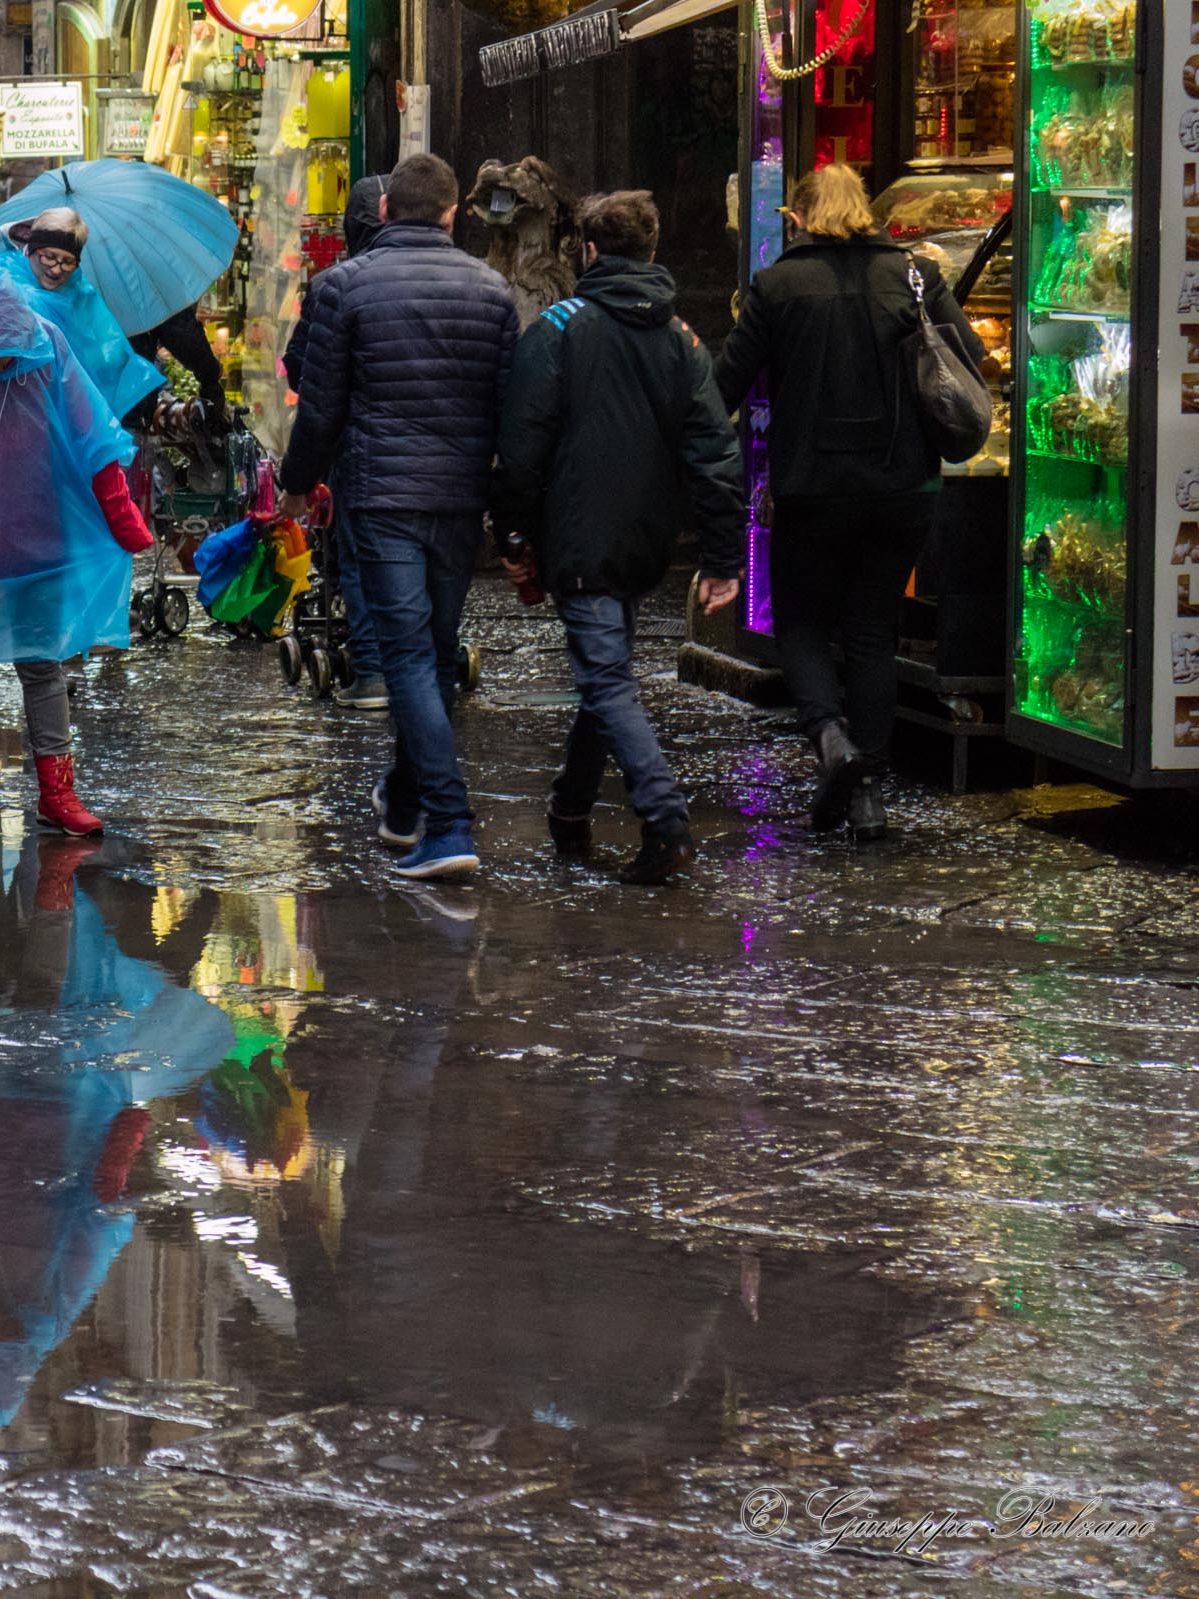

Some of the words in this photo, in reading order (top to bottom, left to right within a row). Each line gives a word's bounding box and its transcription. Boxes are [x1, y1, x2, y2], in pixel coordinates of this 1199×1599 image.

[7, 129, 75, 139] MOZZARELLA
[15, 141, 26, 149] DI
[28, 139, 68, 149] BUFALA
